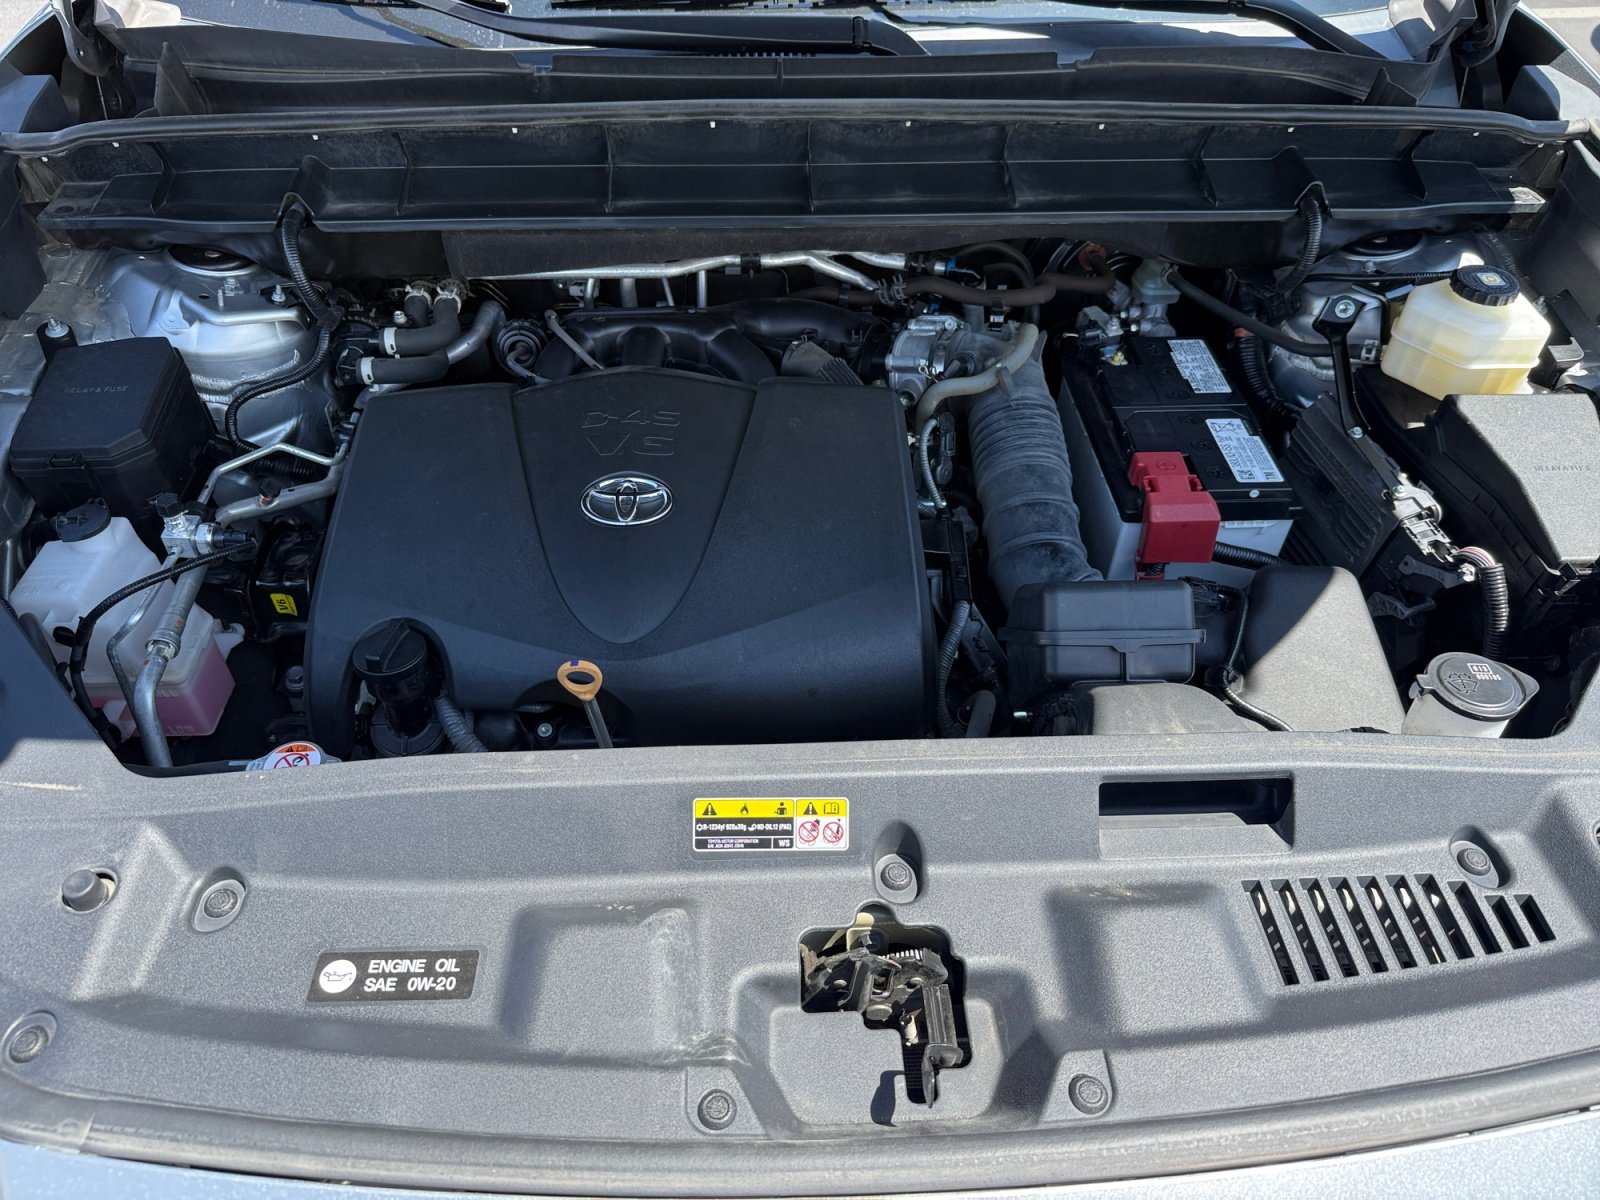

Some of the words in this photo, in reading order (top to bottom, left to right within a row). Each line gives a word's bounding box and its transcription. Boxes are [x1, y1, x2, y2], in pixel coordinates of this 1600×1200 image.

[778, 839, 791, 847] WS
[367, 959, 427, 974] ENGINE
[435, 958, 460, 973] OIL
[363, 977, 398, 992] SAE
[407, 976, 457, 991] 0W-20
